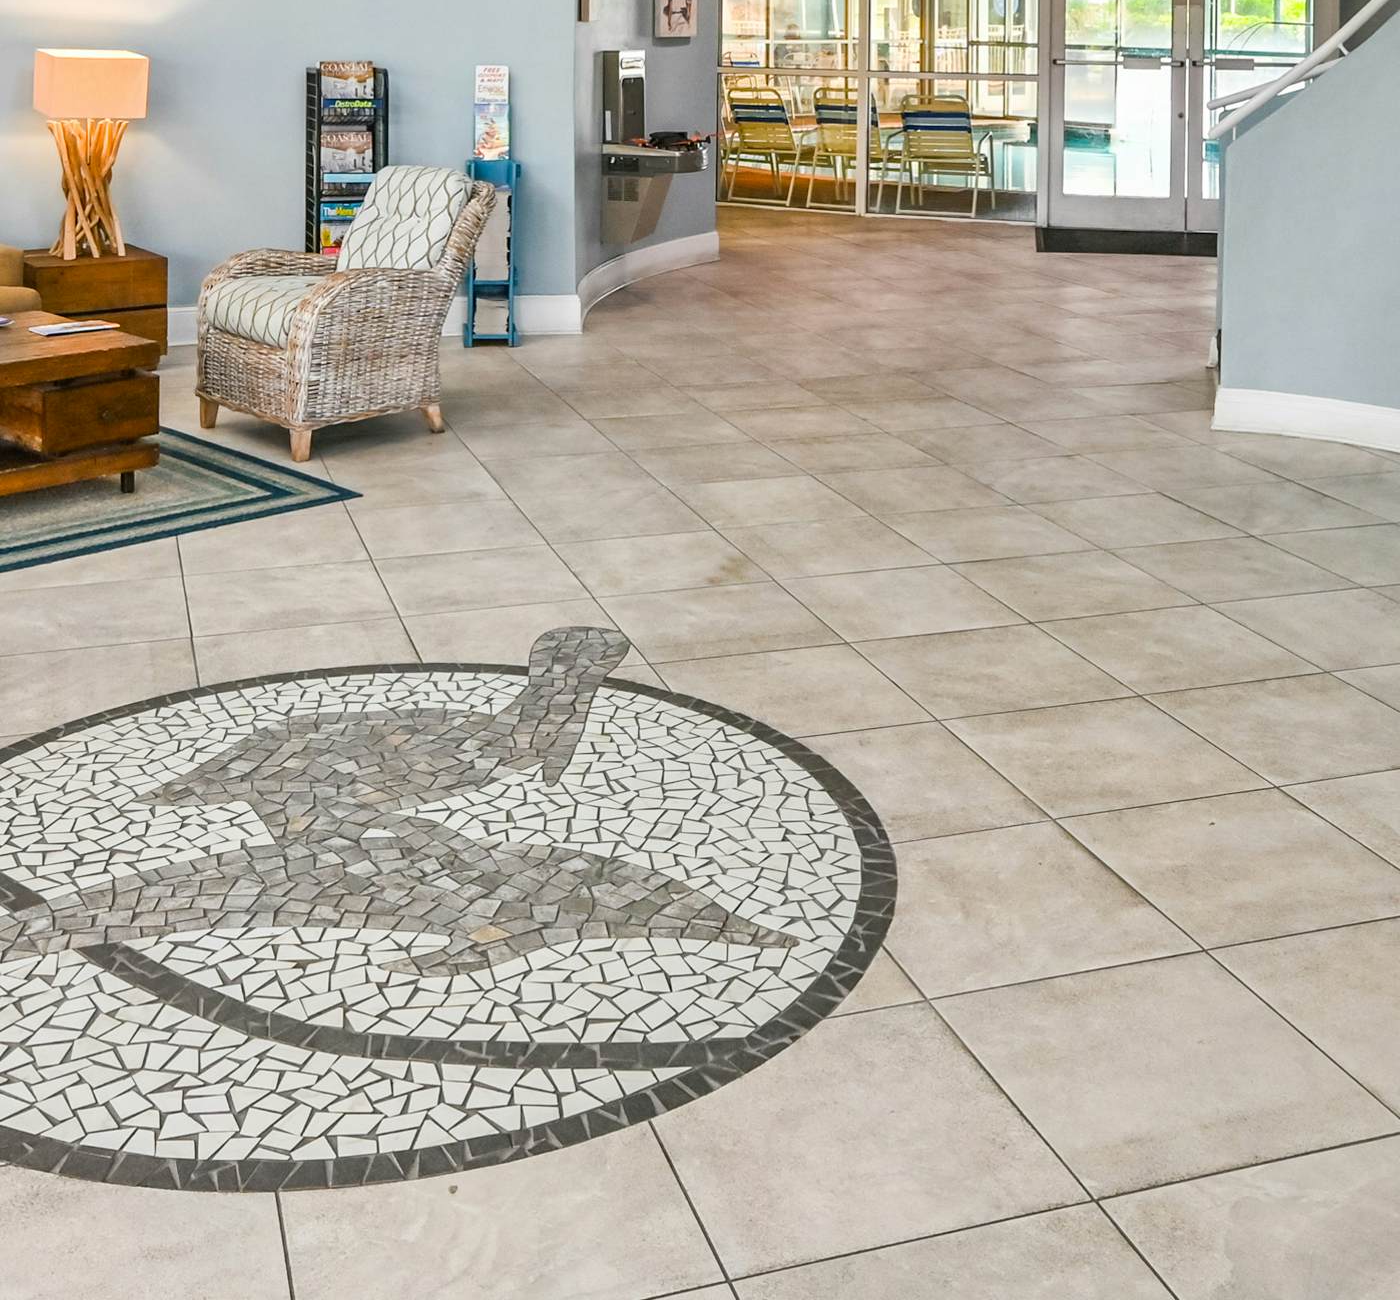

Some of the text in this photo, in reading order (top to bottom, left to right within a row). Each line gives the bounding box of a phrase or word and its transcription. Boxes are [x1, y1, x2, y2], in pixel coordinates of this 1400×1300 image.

[321, 63, 370, 71] COASTAL
[334, 100, 373, 108] DistroData
[320, 134, 370, 142] COASTAL
